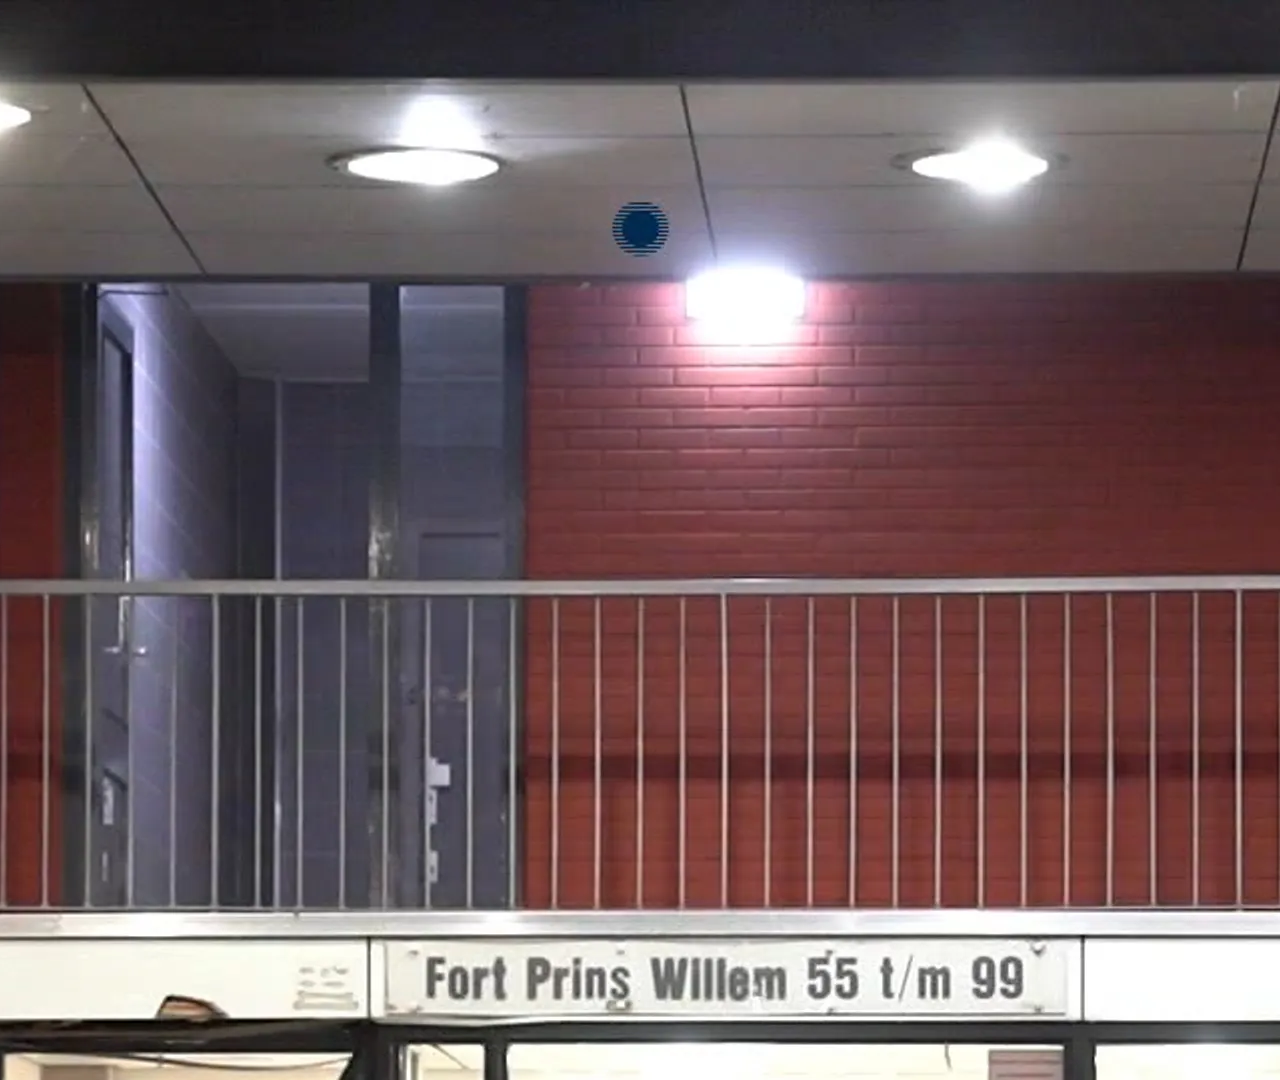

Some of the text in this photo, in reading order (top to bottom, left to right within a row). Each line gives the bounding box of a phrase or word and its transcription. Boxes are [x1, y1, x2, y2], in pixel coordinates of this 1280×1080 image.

[425, 954, 1024, 1002] Fort Prins Willem 55 t/m 99
